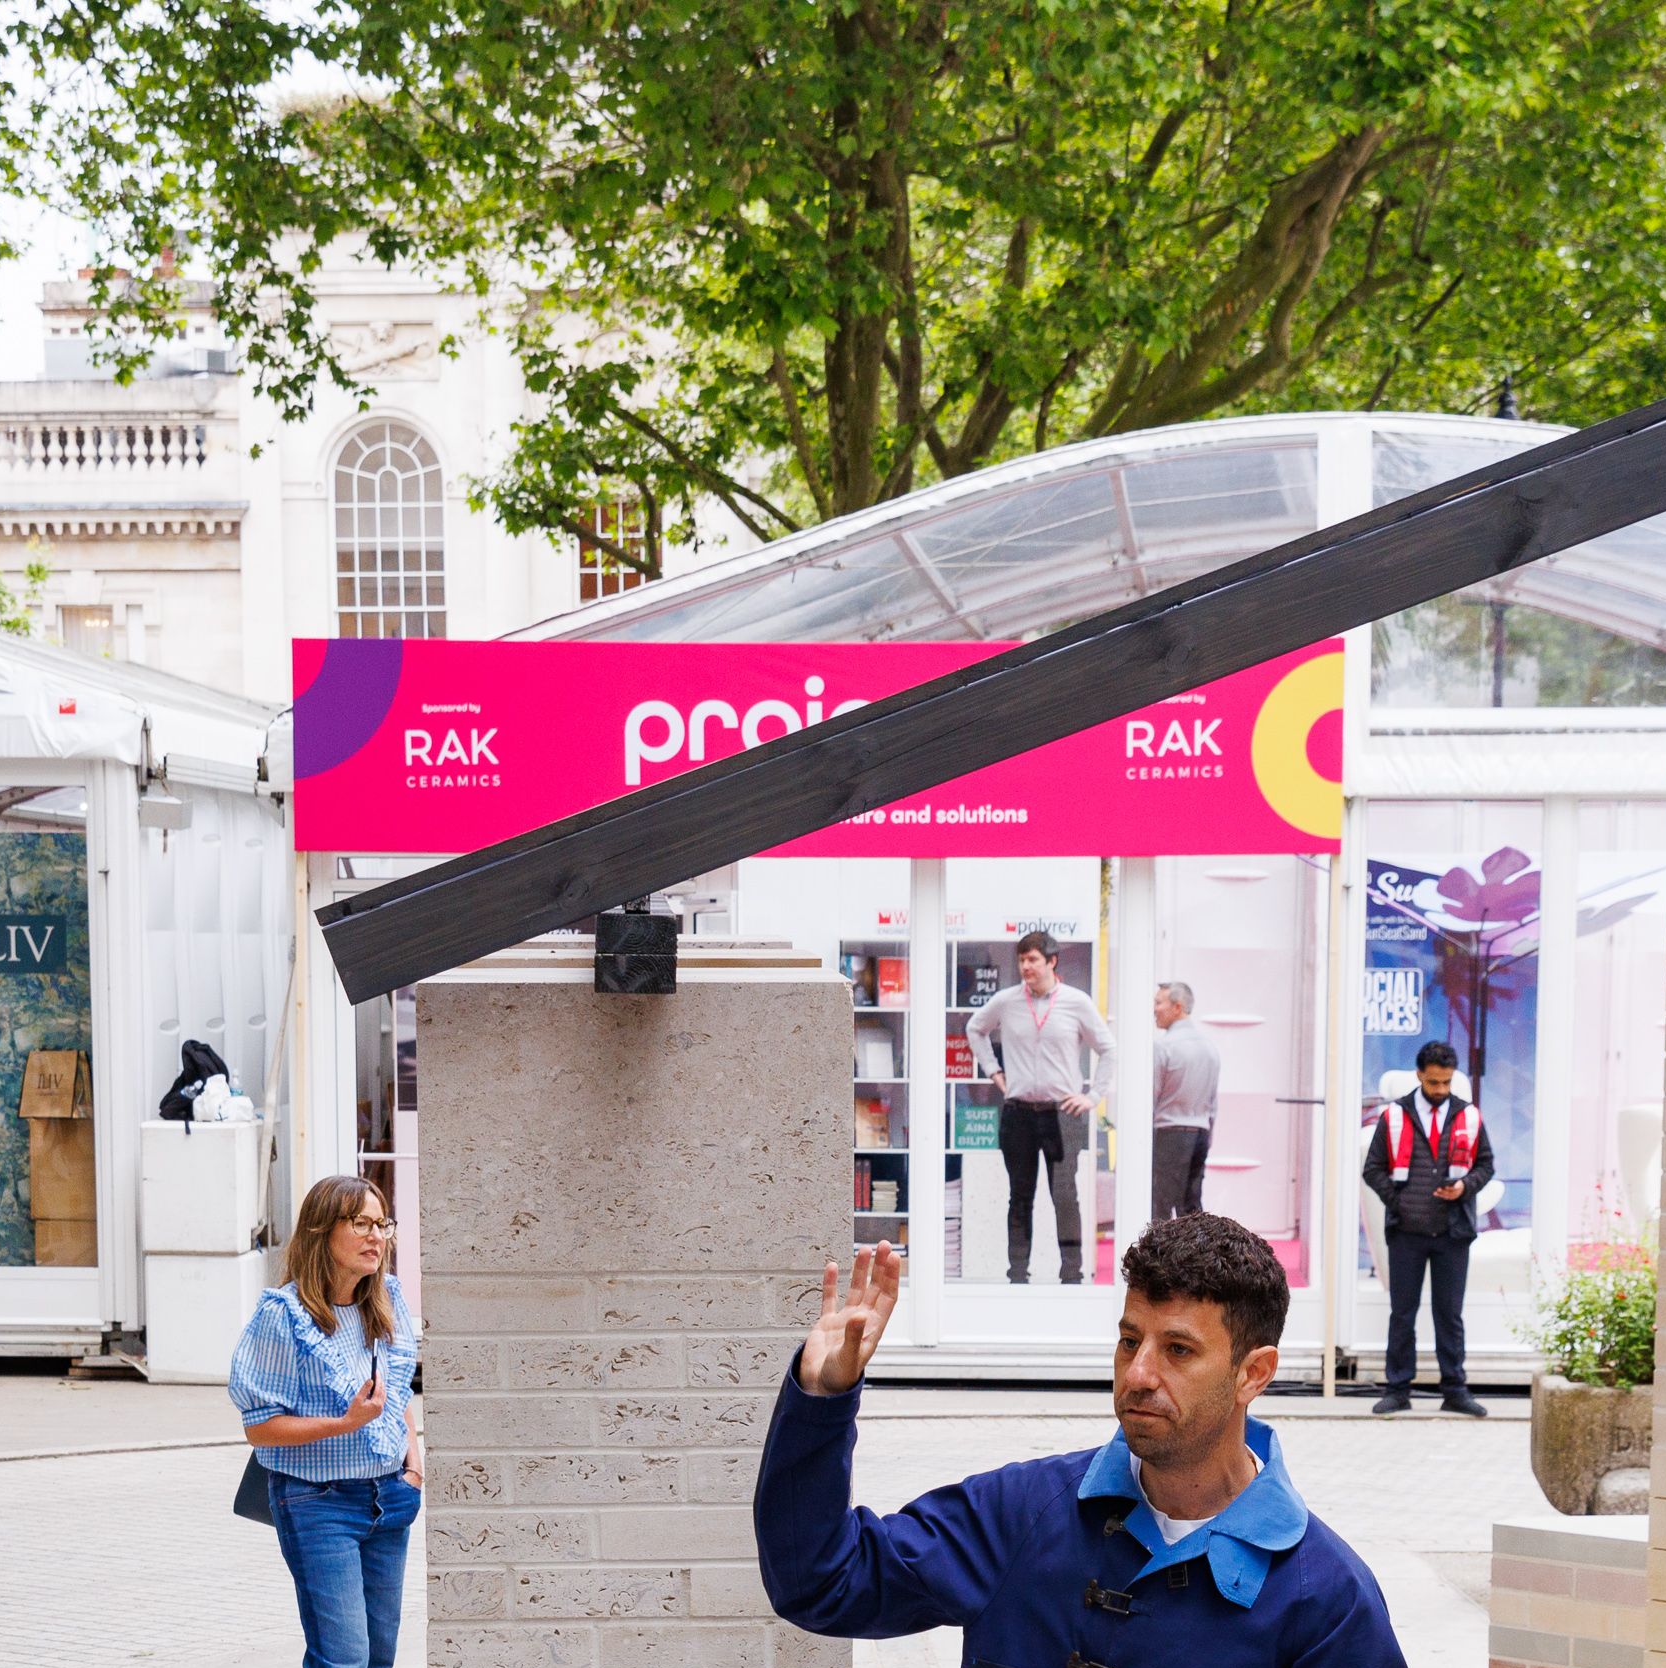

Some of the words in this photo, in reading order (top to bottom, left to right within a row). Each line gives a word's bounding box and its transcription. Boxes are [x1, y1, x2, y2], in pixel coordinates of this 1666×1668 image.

[421, 703, 468, 714] Sponsored
[469, 703, 481, 714] by
[1126, 718, 1223, 758] RAK
[404, 728, 500, 766] RAK
[1126, 765, 1224, 780] CERAMICS
[406, 774, 501, 788] CERAMICS
[890, 804, 931, 824] and
[935, 804, 1029, 824] solutions
[975, 968, 998, 980] SIM
[977, 981, 997, 993] PLI
[964, 1110, 995, 1120] SUST
[957, 1135, 995, 1146] BILITY
